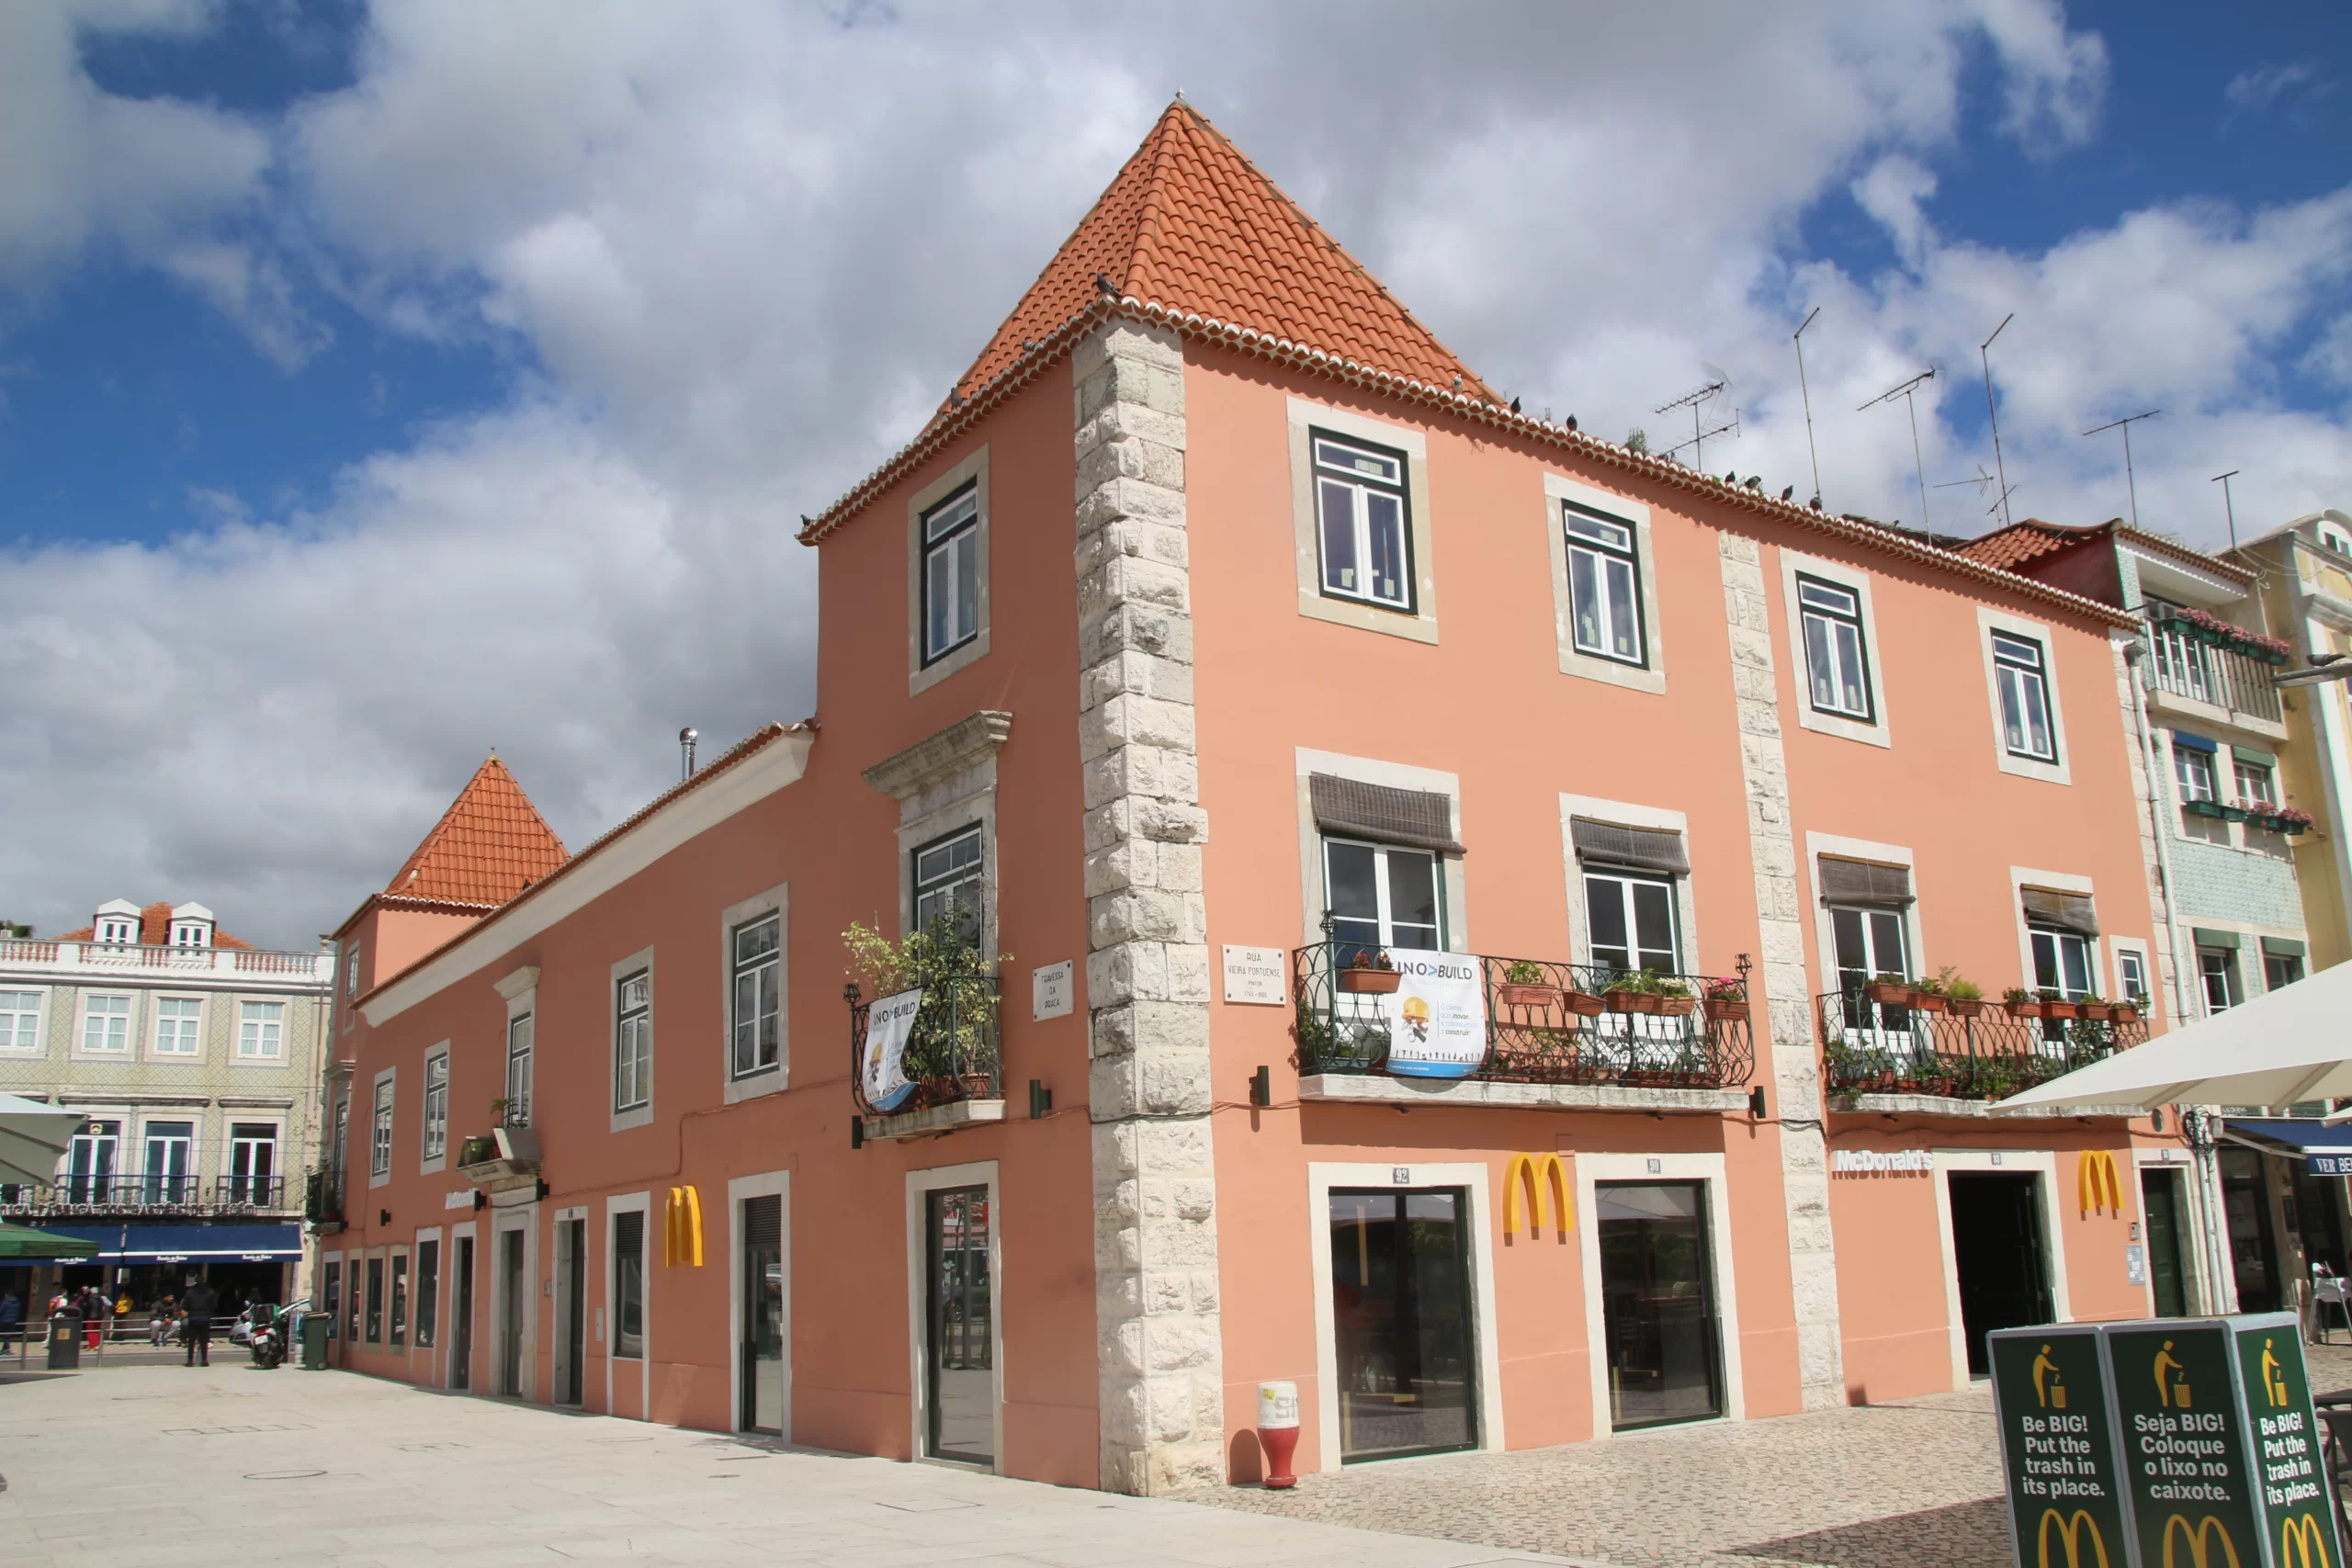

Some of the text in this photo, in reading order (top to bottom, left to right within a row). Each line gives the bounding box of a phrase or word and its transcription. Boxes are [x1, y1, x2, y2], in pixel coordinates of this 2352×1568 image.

[1247, 952, 1262, 963] RUA
[1041, 971, 1064, 984] TRAVESSA
[1228, 964, 1281, 977] VIEIRA PORTUENSE
[1049, 986, 1056, 995] DA
[1649, 1159, 1659, 1172] 90
[1834, 1149, 1933, 1171] McDonald's
[2315, 1157, 2337, 1173] VER
[1396, 1168, 1408, 1183] 92
[2022, 1415, 2088, 1433] Be BIG!
[2133, 1412, 2225, 1437] Seja BIG!
[2259, 1411, 2303, 1436] Be BIG!
[2024, 1436, 2091, 1454] Put the
[2141, 1435, 2226, 1459] Coloque
[2263, 1435, 2307, 1459] Put the
[2024, 1456, 2096, 1474] trash in
[2144, 1456, 2229, 1477] o lixo no
[2267, 1455, 2312, 1482] trash in
[2022, 1476, 2106, 1500] its place.
[2150, 1480, 2232, 1501] caixote.
[2266, 1481, 2321, 1506] its place.
